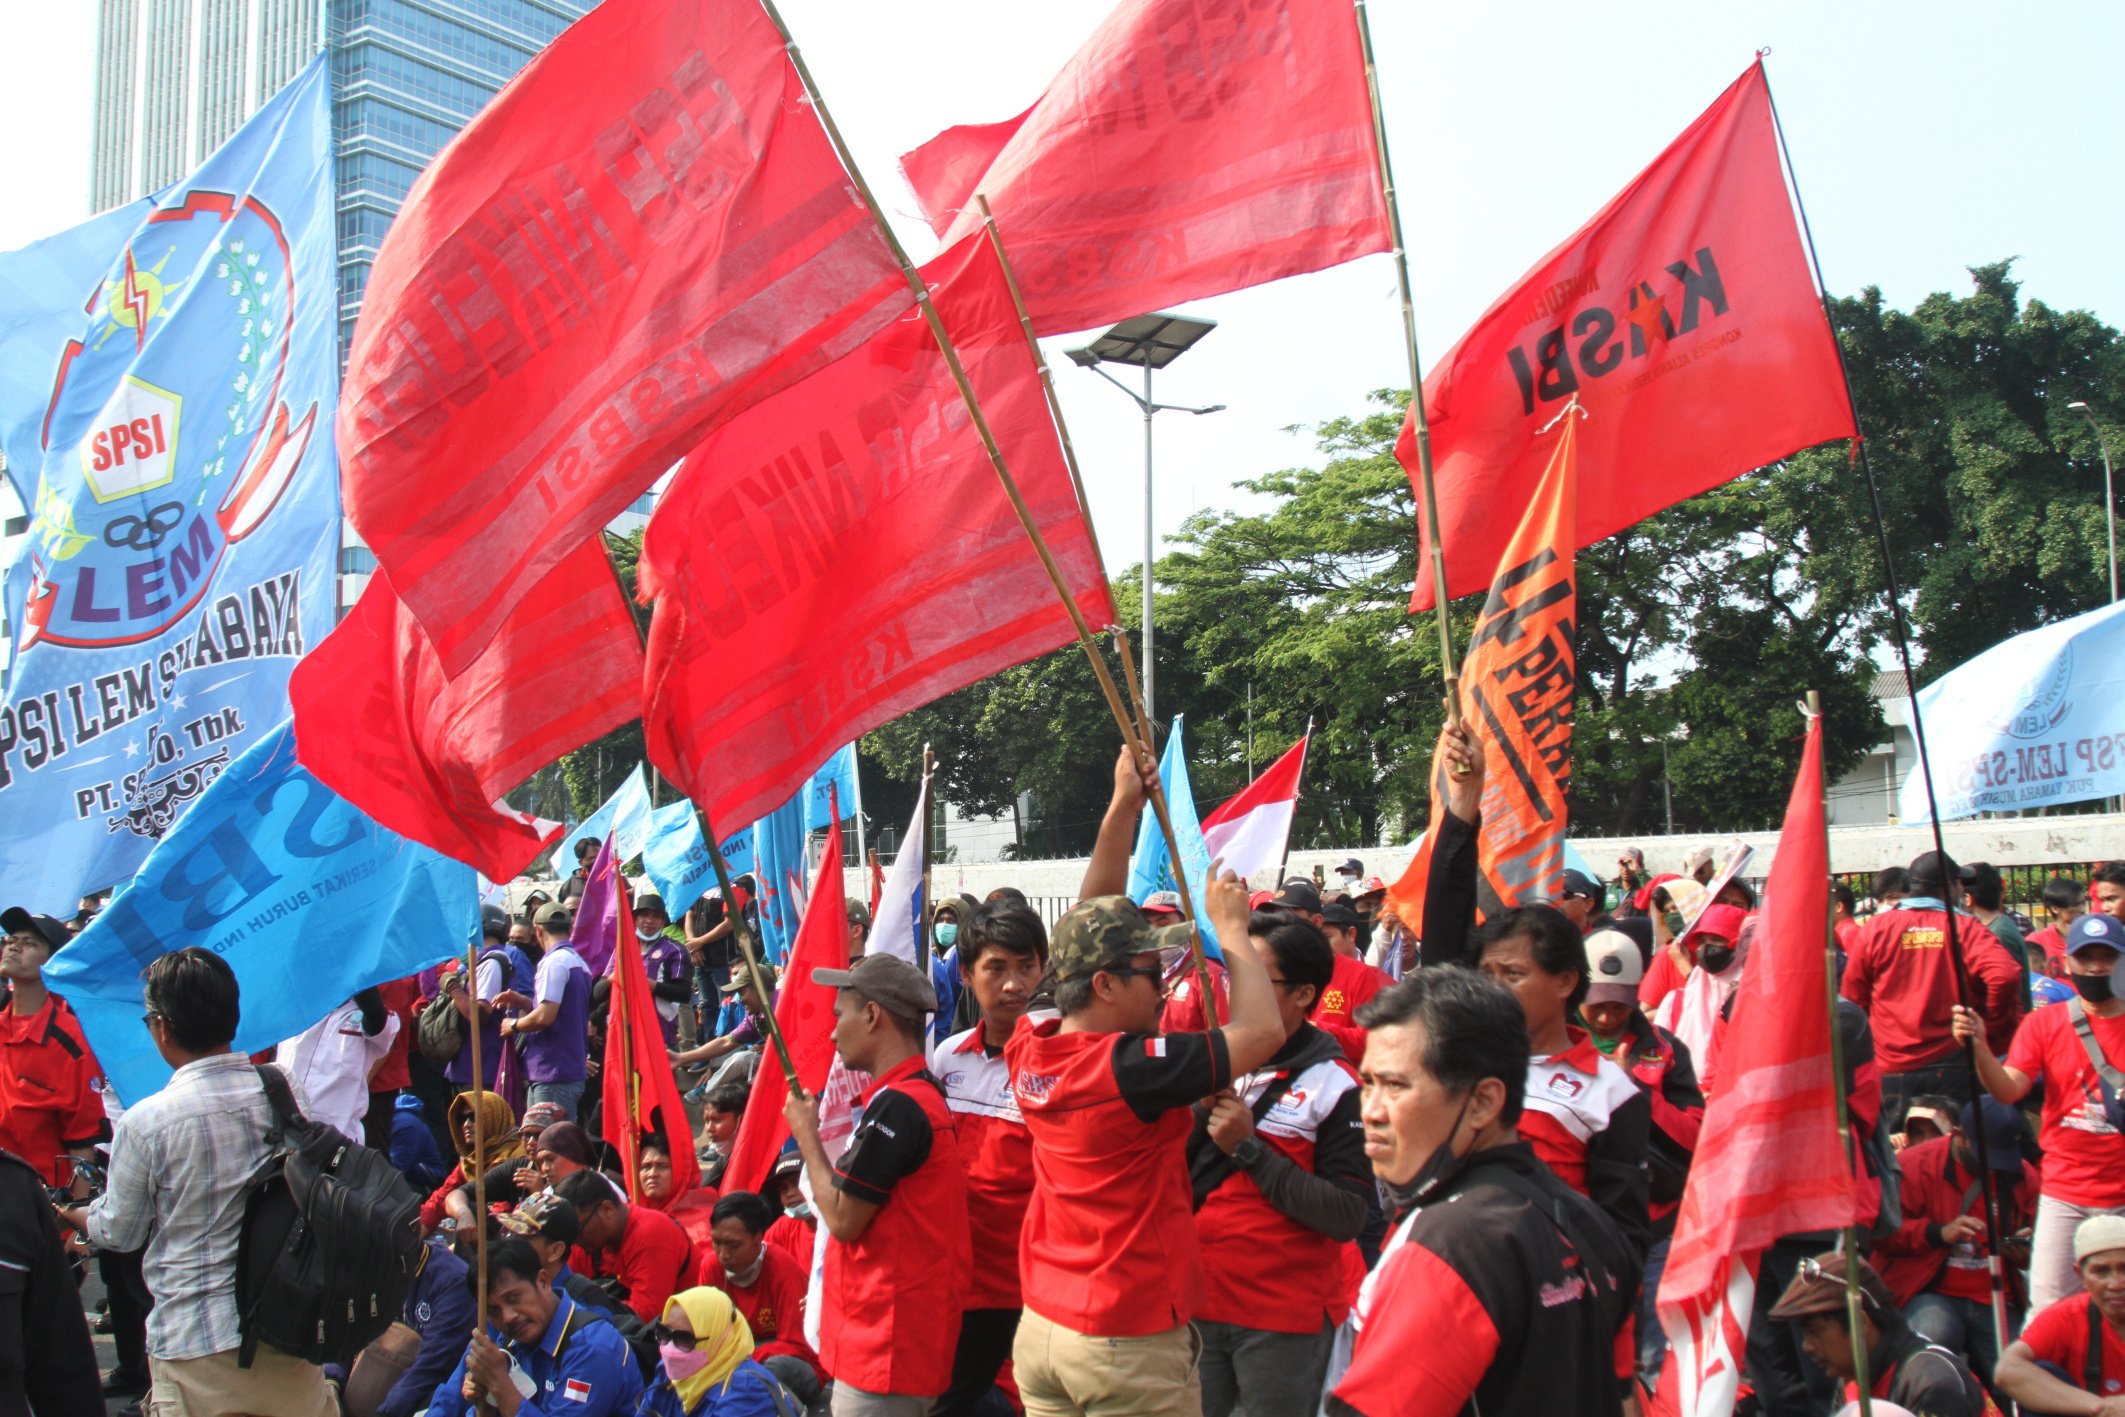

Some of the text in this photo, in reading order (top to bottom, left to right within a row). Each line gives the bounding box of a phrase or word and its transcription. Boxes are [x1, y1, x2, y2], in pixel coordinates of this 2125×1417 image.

[92, 414, 165, 471] SPSI
[70, 513, 215, 623] LEM
[67, 660, 156, 747] LEM
[76, 782, 119, 819] PT.
[184, 706, 246, 750] Tbk.
